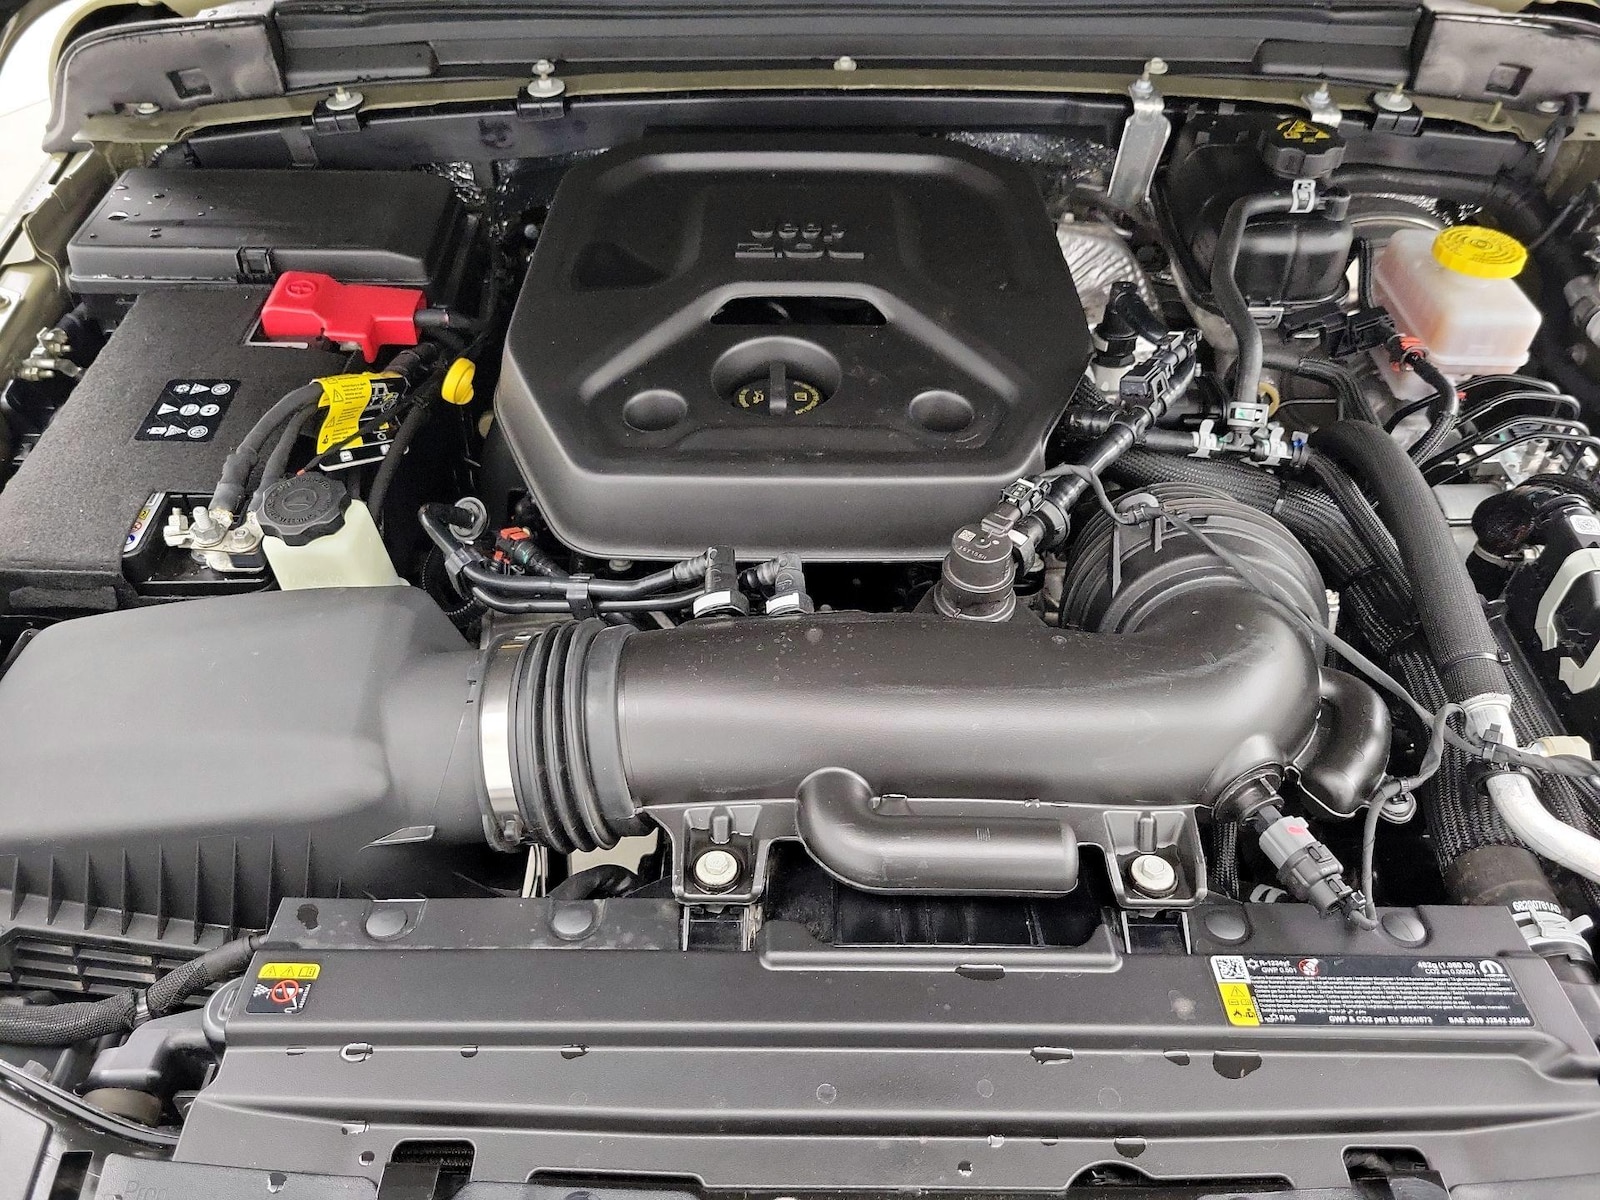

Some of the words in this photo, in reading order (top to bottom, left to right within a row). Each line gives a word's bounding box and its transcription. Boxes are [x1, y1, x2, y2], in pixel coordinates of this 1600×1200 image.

[1279, 1014, 1297, 1023] PAG
[1328, 1015, 1348, 1024] GWP
[1356, 1016, 1373, 1024] CO2
[1374, 1017, 1387, 1026] per
[1387, 1016, 1399, 1024] EU
[1447, 1016, 1466, 1025] SAE
